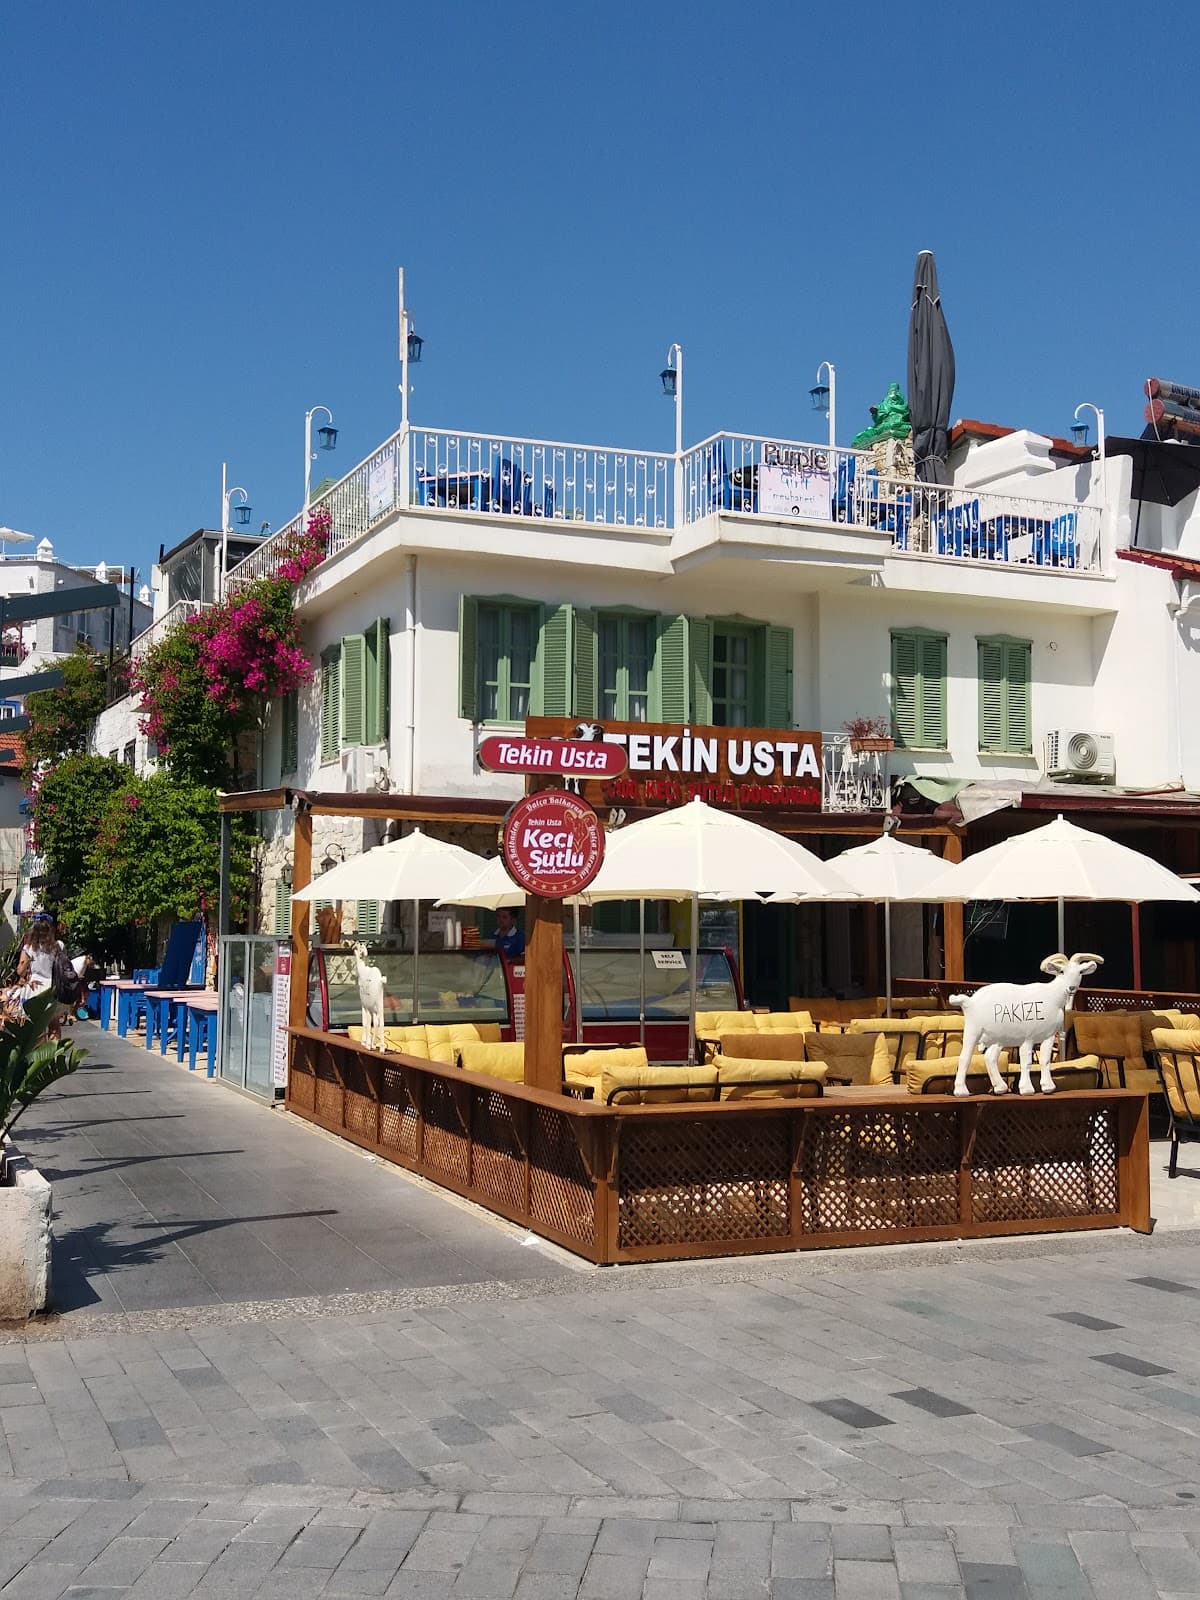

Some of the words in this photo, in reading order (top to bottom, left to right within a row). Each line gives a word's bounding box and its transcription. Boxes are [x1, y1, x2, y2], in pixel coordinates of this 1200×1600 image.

[763, 443, 826, 473] Purple
[498, 743, 553, 766] Tekin
[560, 747, 607, 769] Usta
[728, 739, 820, 777] USTA
[740, 784, 820, 805] DONDURMA
[546, 818, 562, 826] Usta
[523, 828, 574, 848] Keçi
[528, 849, 584, 867] Sütlü
